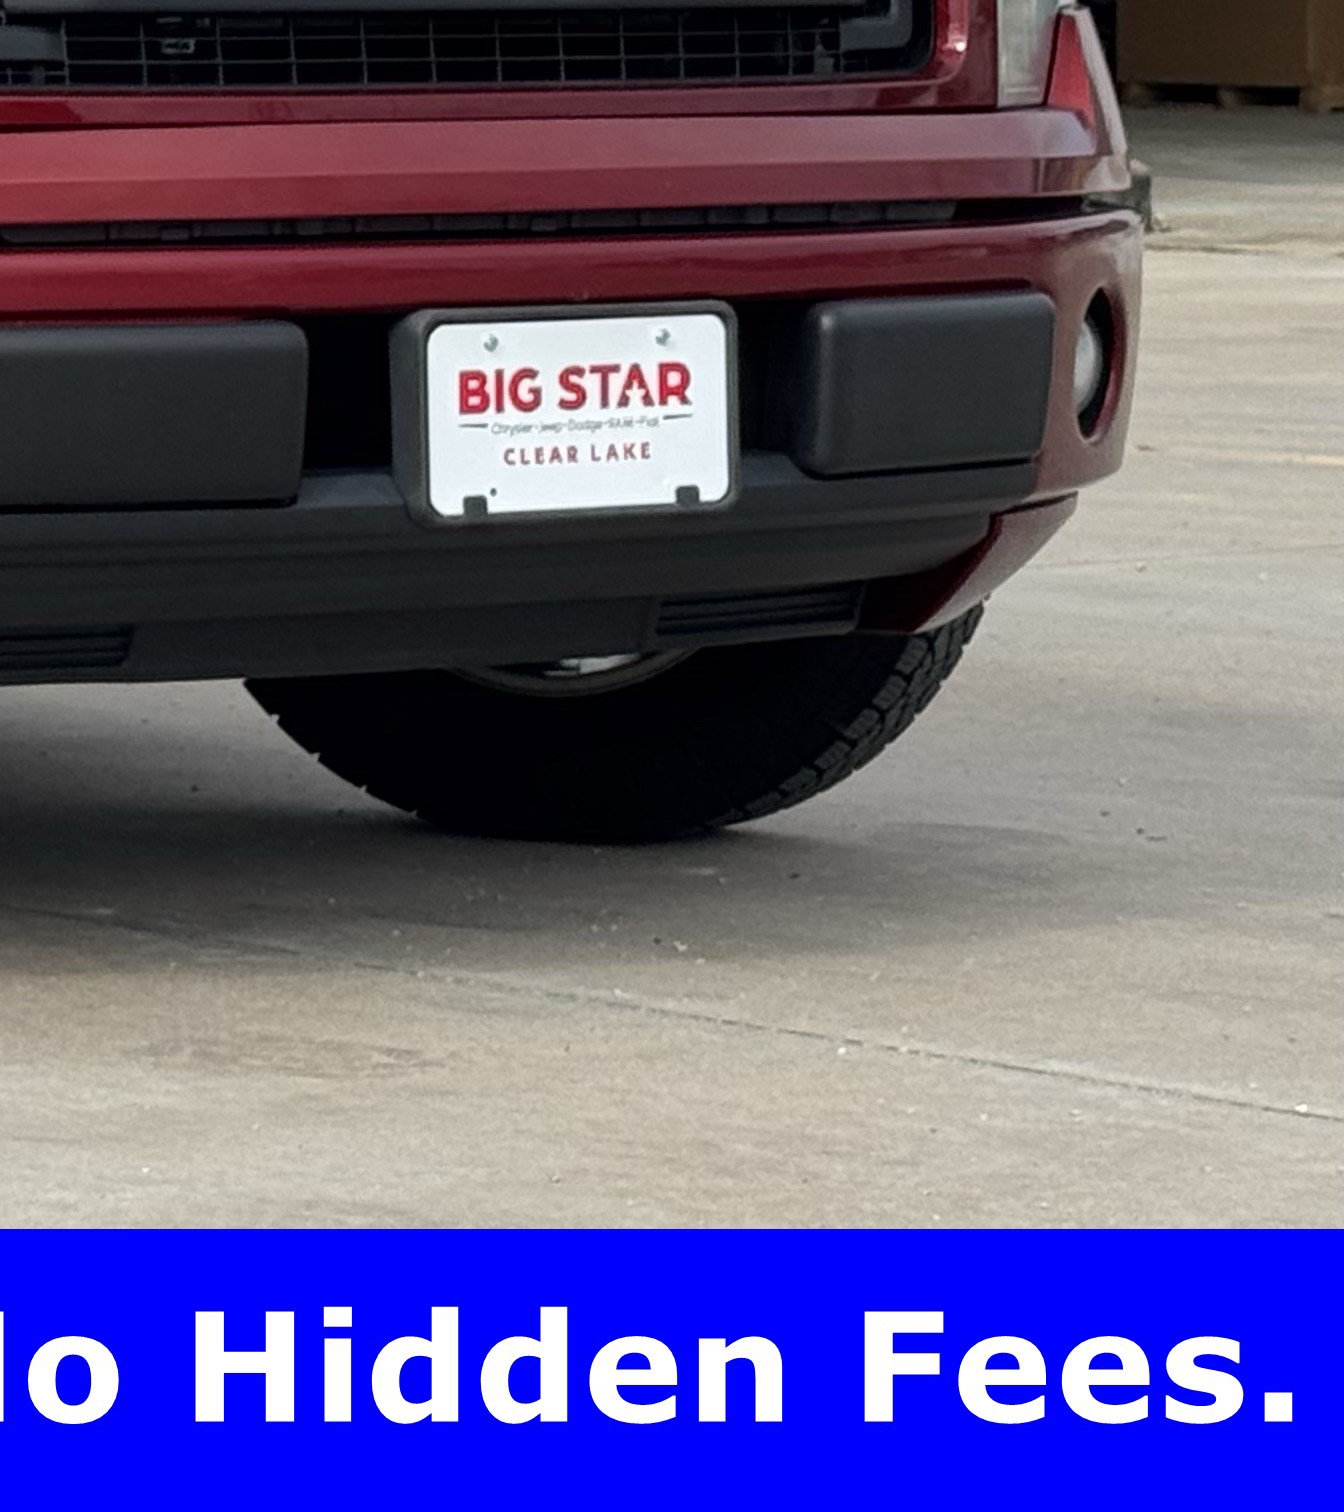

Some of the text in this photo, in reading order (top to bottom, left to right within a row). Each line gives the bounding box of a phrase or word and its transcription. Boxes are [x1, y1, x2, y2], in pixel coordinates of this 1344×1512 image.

[459, 361, 693, 416] BIG STAR
[503, 441, 652, 466] CLEAR LAKE
